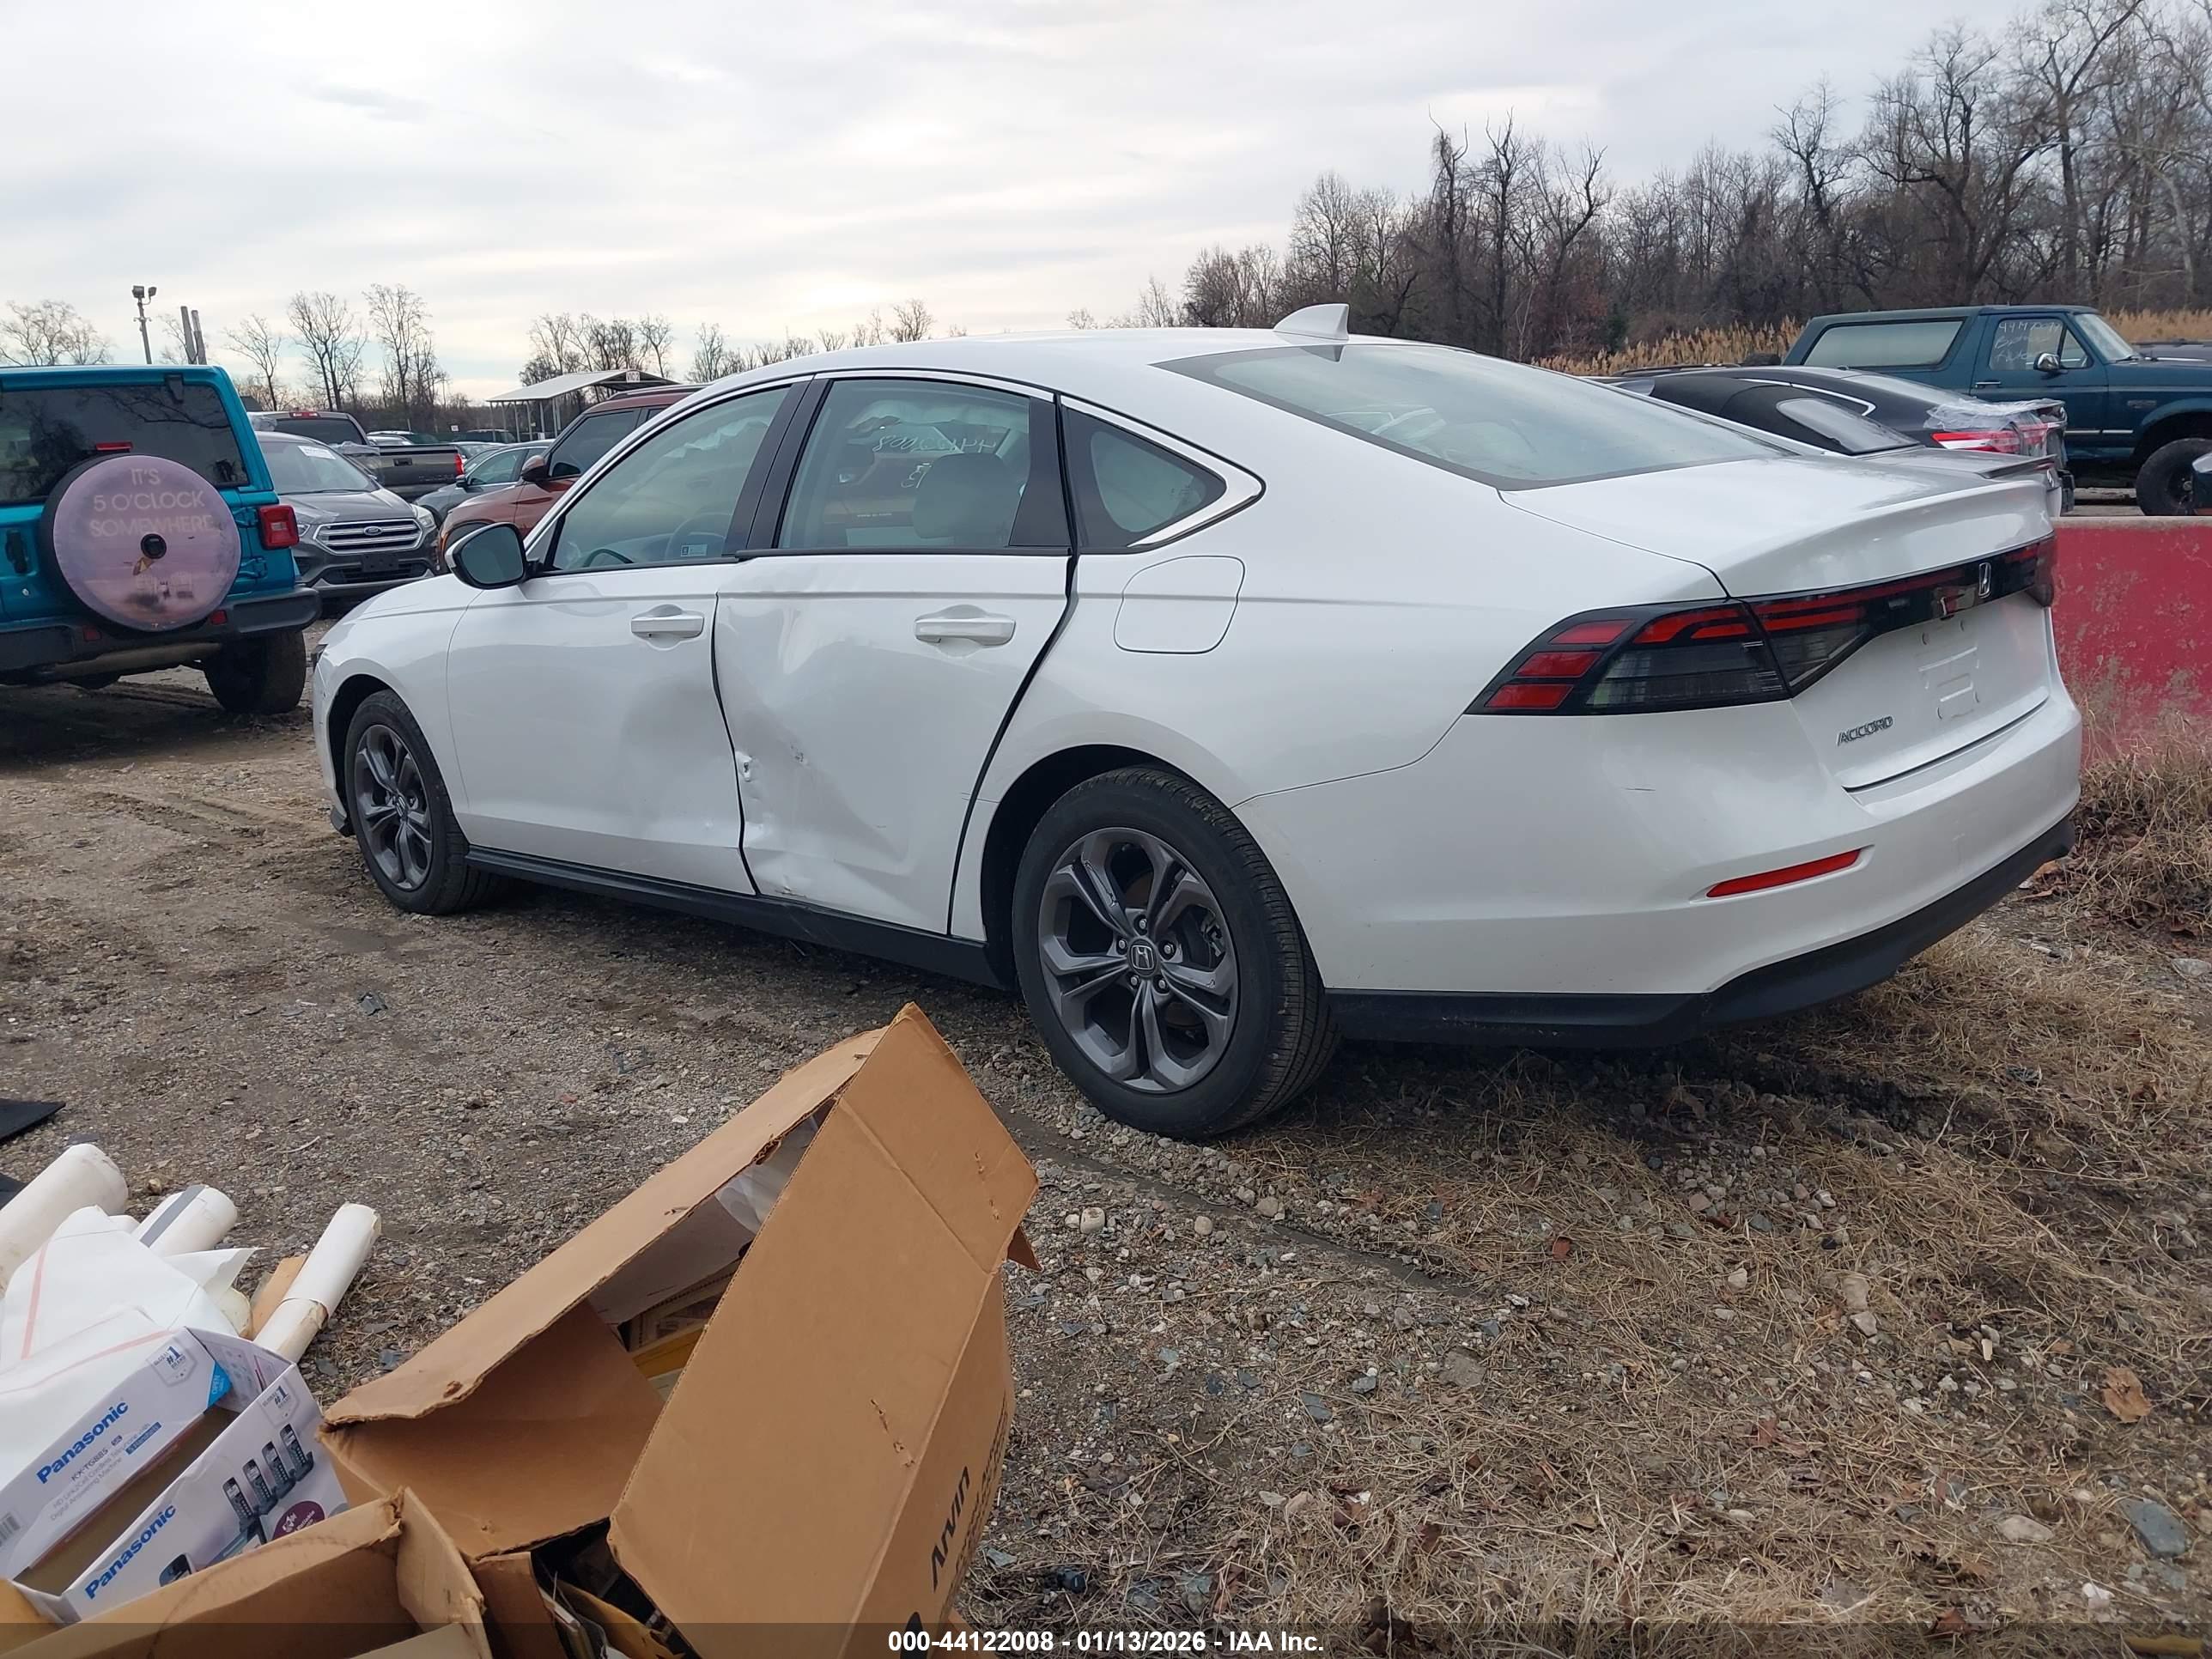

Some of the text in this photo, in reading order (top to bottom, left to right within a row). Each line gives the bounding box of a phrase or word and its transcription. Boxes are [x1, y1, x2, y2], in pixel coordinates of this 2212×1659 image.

[131, 468, 161, 486] IT'S
[94, 490, 205, 512] 5 O'CLOCK
[89, 514, 215, 537] SOMEWHERE
[1837, 715, 1893, 746] ACCORD
[36, 1401, 129, 1484] Panasonic
[84, 1504, 176, 1599] Panasonic
